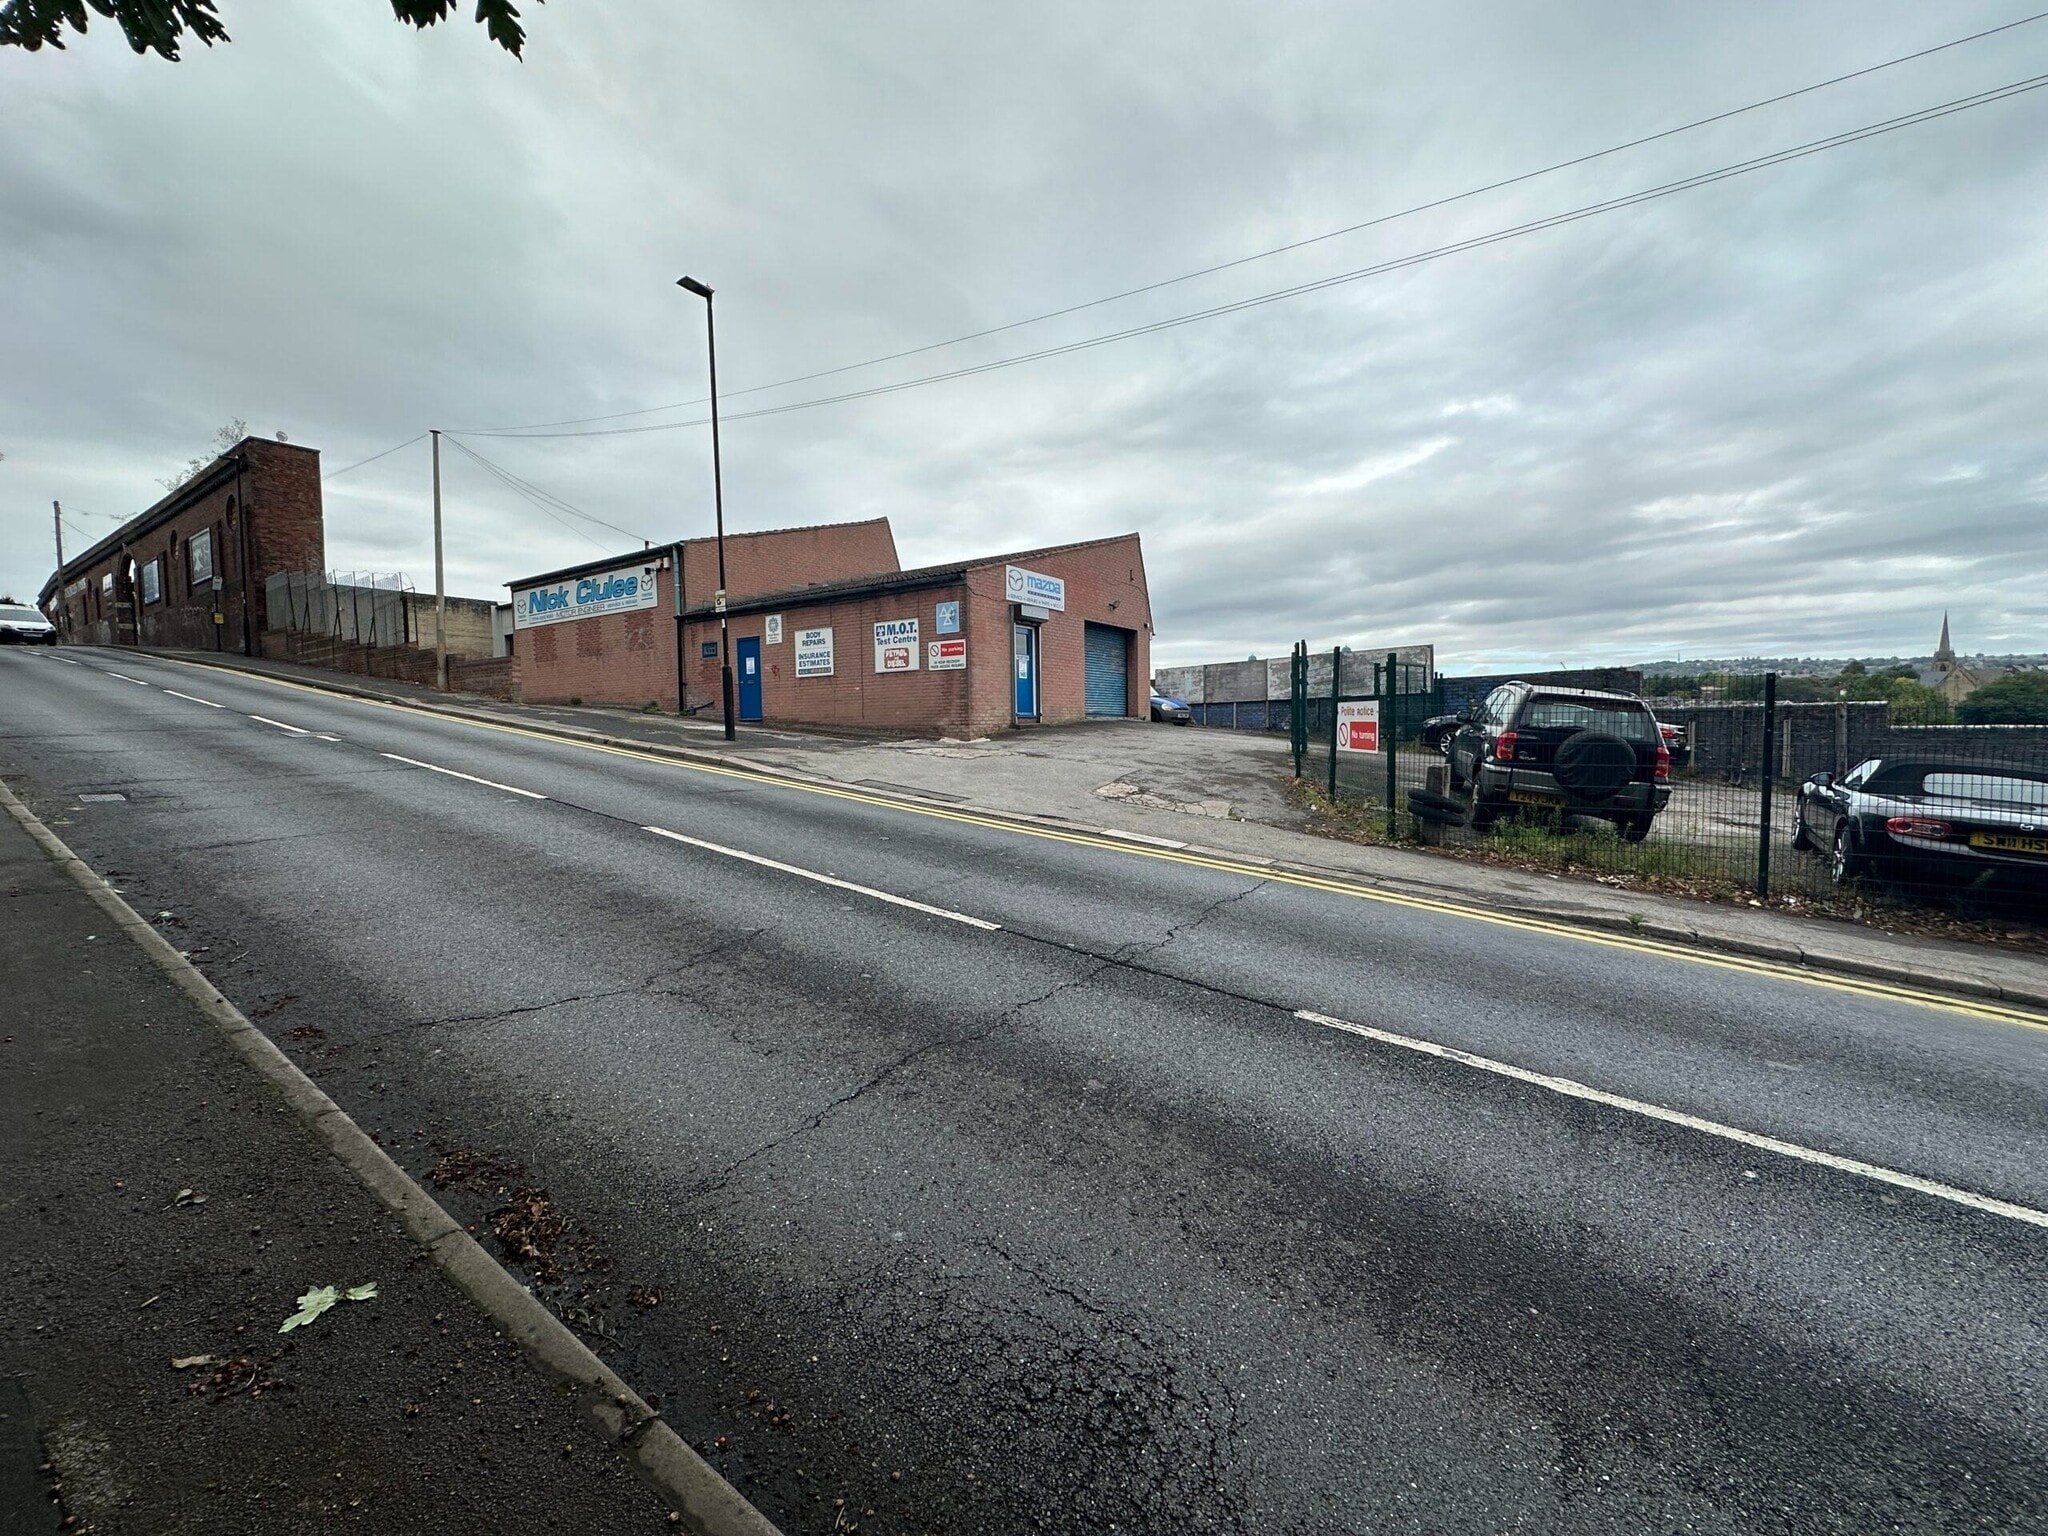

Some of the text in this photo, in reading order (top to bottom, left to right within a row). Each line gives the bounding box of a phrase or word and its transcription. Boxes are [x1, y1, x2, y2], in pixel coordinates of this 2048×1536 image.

[1027, 576, 1061, 594] mazda
[528, 575, 638, 614] Nick Clulee
[555, 609, 577, 619] MOTOR
[577, 604, 605, 616] ENGINEER
[886, 622, 917, 636] M.O.T.
[805, 631, 821, 639] BODY
[801, 638, 826, 647] REPAIRS
[876, 636, 917, 646] Test Centre
[798, 651, 831, 660] INSURANCE
[885, 648, 908, 658] PETROL
[798, 658, 831, 668] ESTIMATES
[887, 658, 907, 667] DIESEL
[1341, 706, 1374, 716] Polite notice
[1351, 730, 1375, 742] No turning
[2021, 838, 2048, 852] HS
